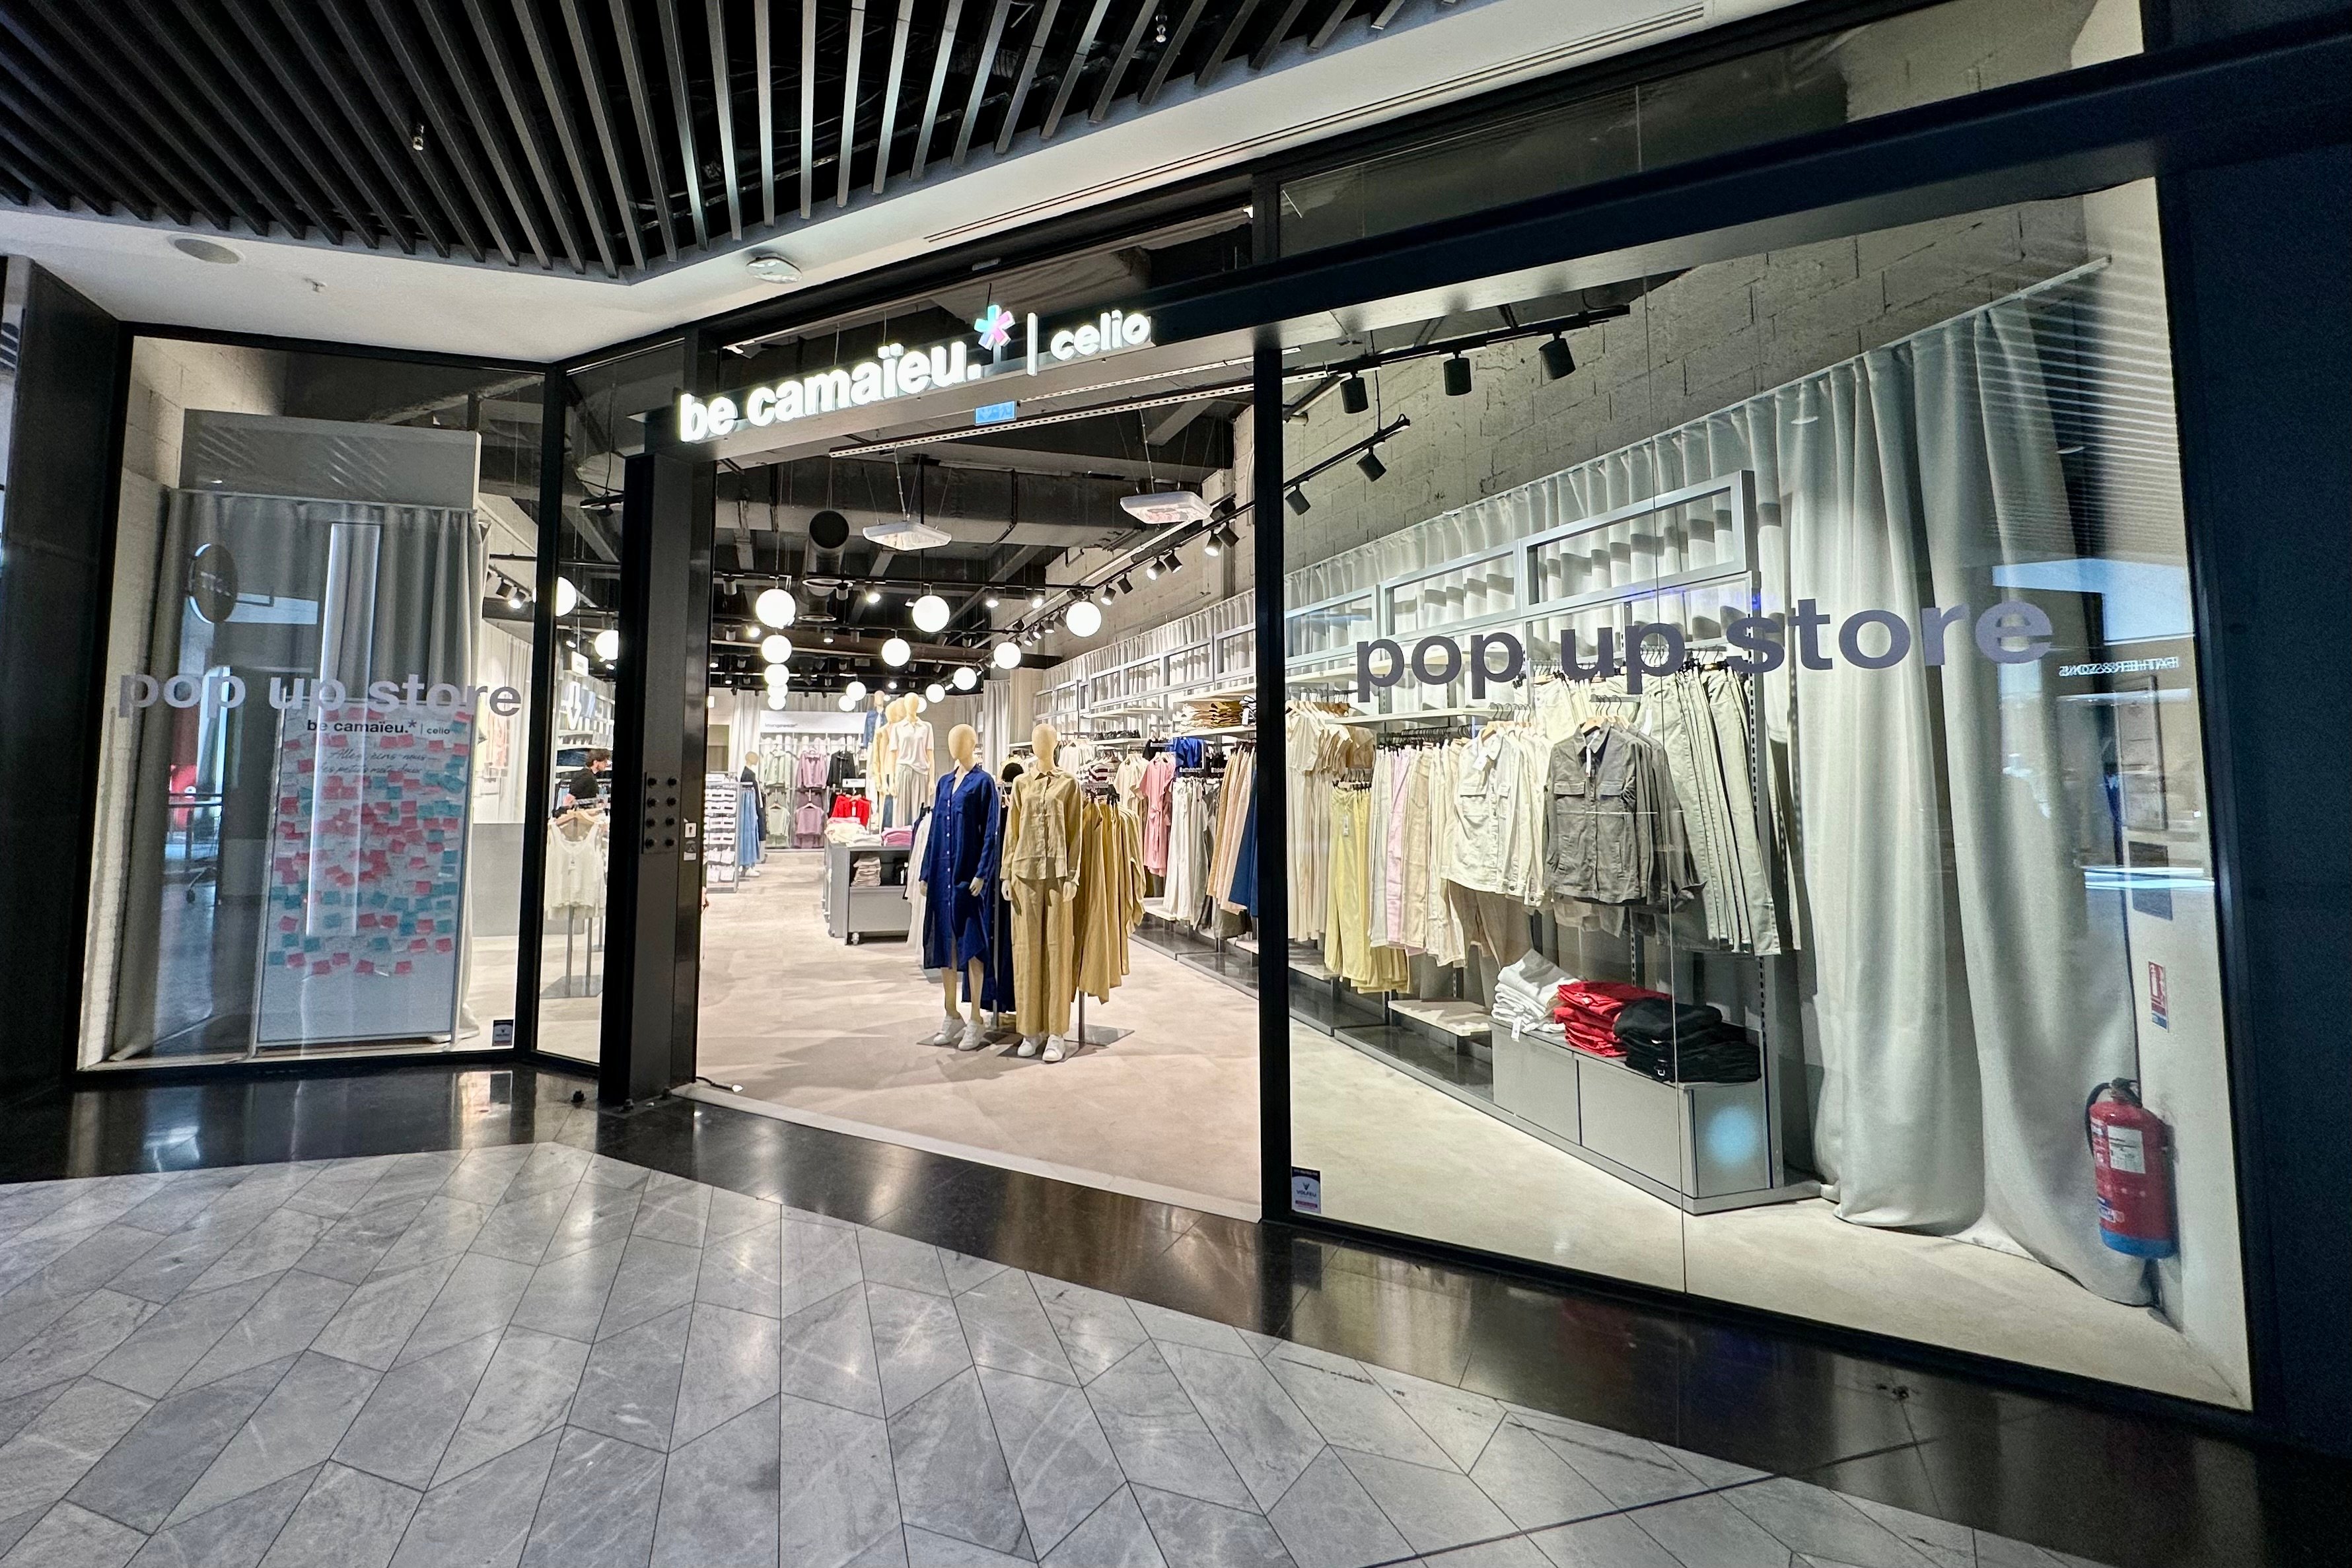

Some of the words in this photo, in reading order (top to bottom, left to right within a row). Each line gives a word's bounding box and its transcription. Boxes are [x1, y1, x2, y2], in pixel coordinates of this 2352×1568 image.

[680, 394, 738, 441] be
[746, 340, 981, 427] camaïeu.
[1050, 310, 1151, 361] celio
[1357, 632, 1523, 703] pop
[1561, 622, 1685, 695] up
[1726, 598, 2053, 674] store
[119, 674, 246, 719] pop
[269, 677, 346, 720] up
[369, 674, 522, 717] store
[307, 719, 328, 731] be
[334, 721, 409, 733] camaïeu.
